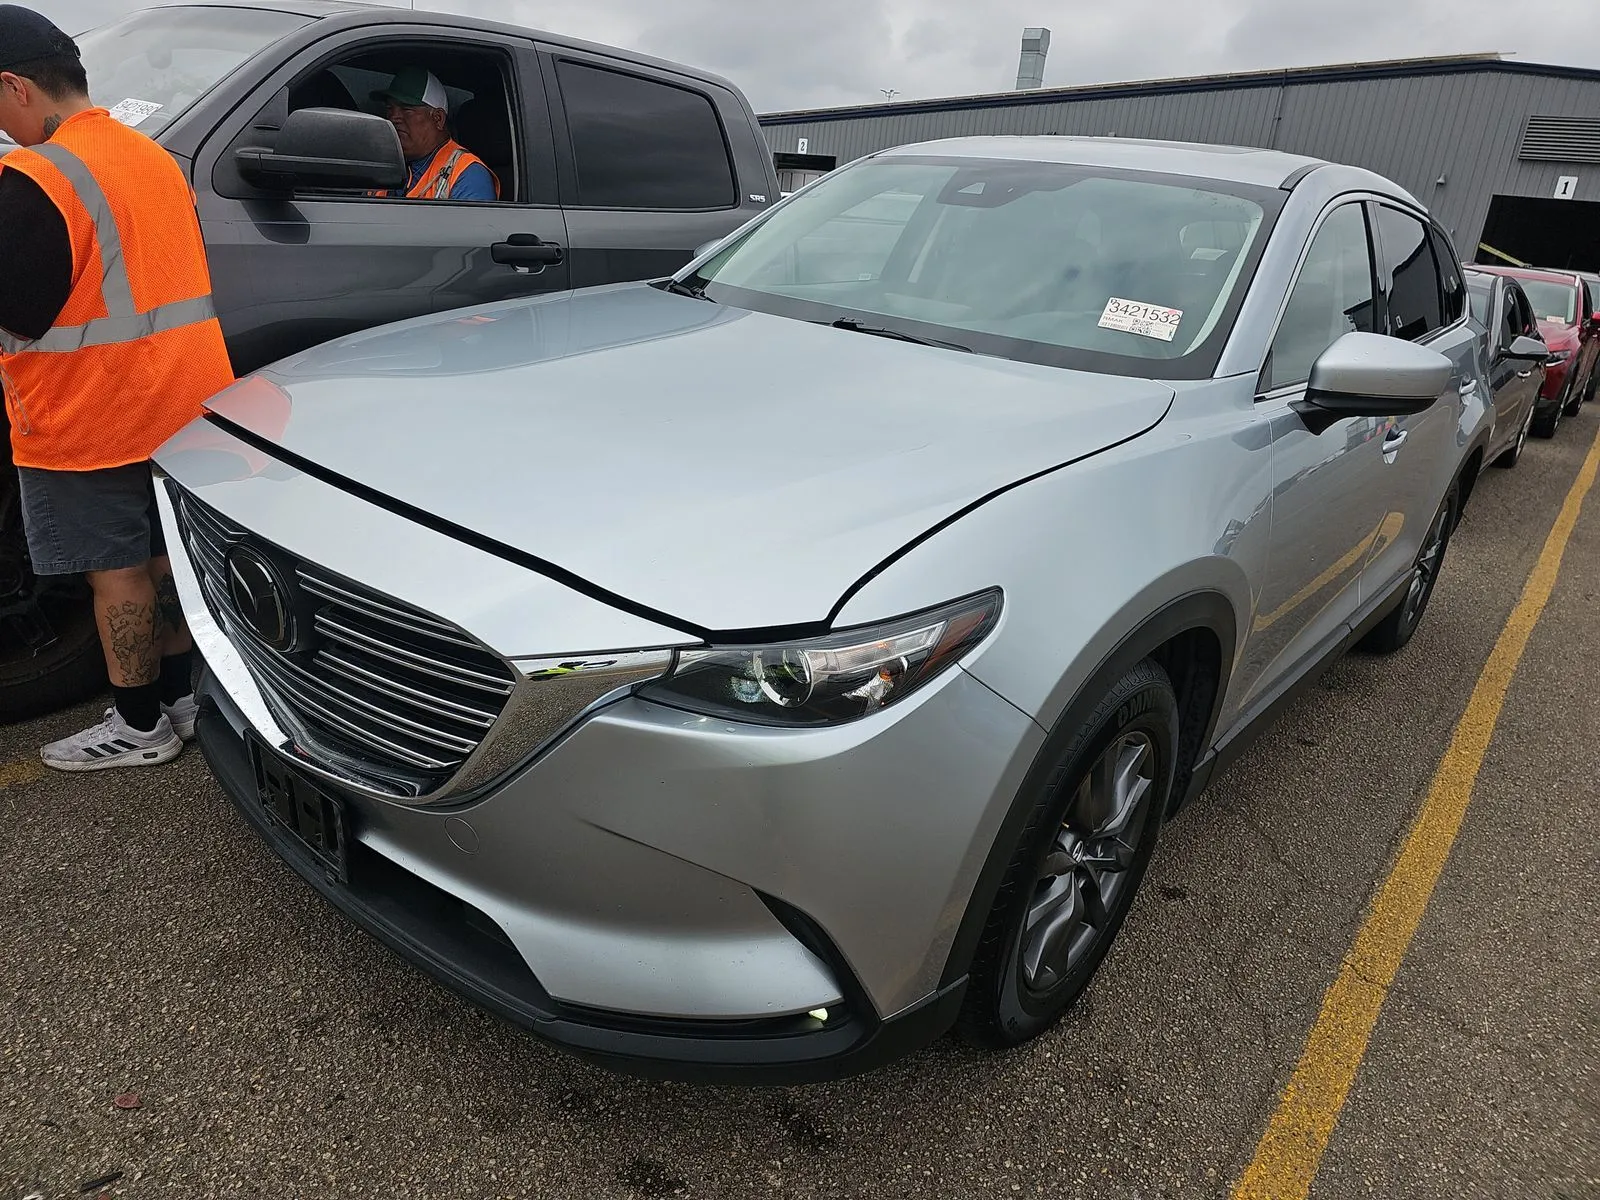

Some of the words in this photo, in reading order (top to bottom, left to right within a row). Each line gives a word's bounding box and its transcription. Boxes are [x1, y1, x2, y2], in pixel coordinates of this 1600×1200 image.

[800, 141, 806, 151] 2
[1561, 181, 1569, 194] 1
[750, 194, 766, 203] SR5
[1109, 301, 1181, 325] 3421532
